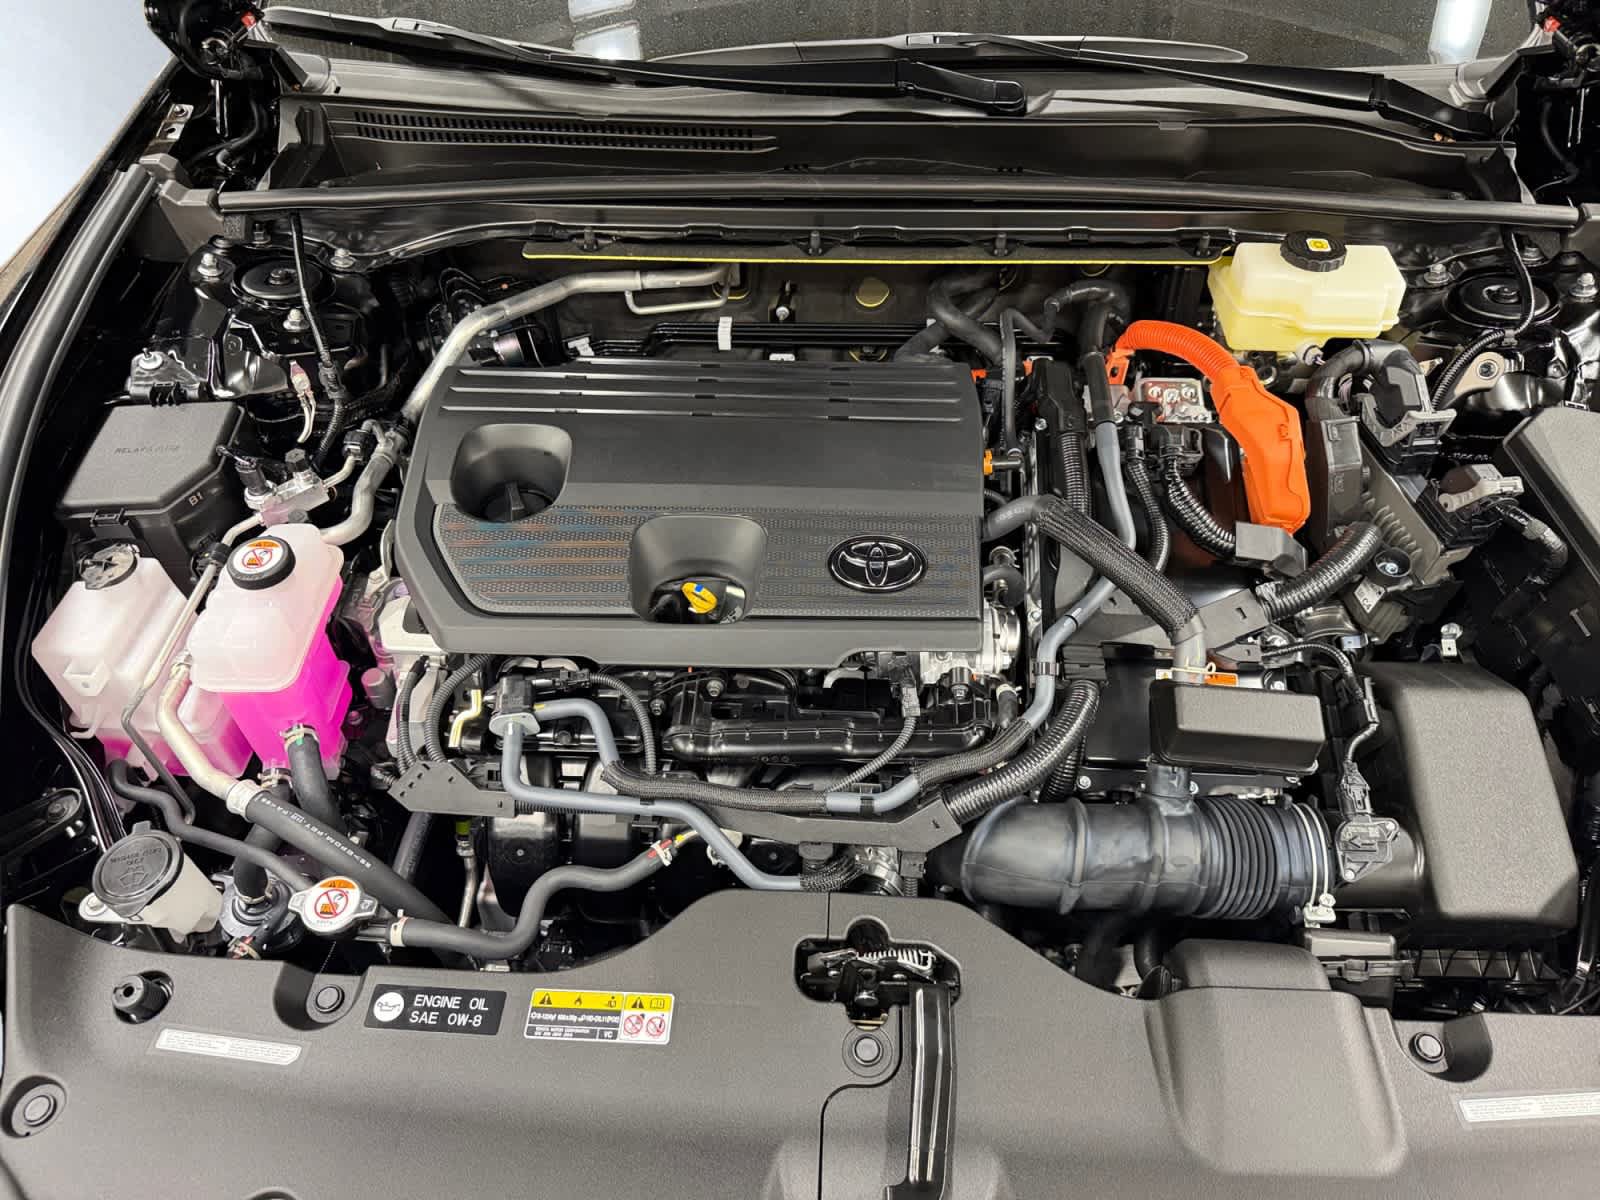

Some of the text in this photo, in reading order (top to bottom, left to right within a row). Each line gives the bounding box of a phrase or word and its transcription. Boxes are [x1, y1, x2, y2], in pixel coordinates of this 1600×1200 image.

[413, 994, 489, 1011] ENGINE OIL
[409, 1011, 483, 1027] SAE 0W-8
